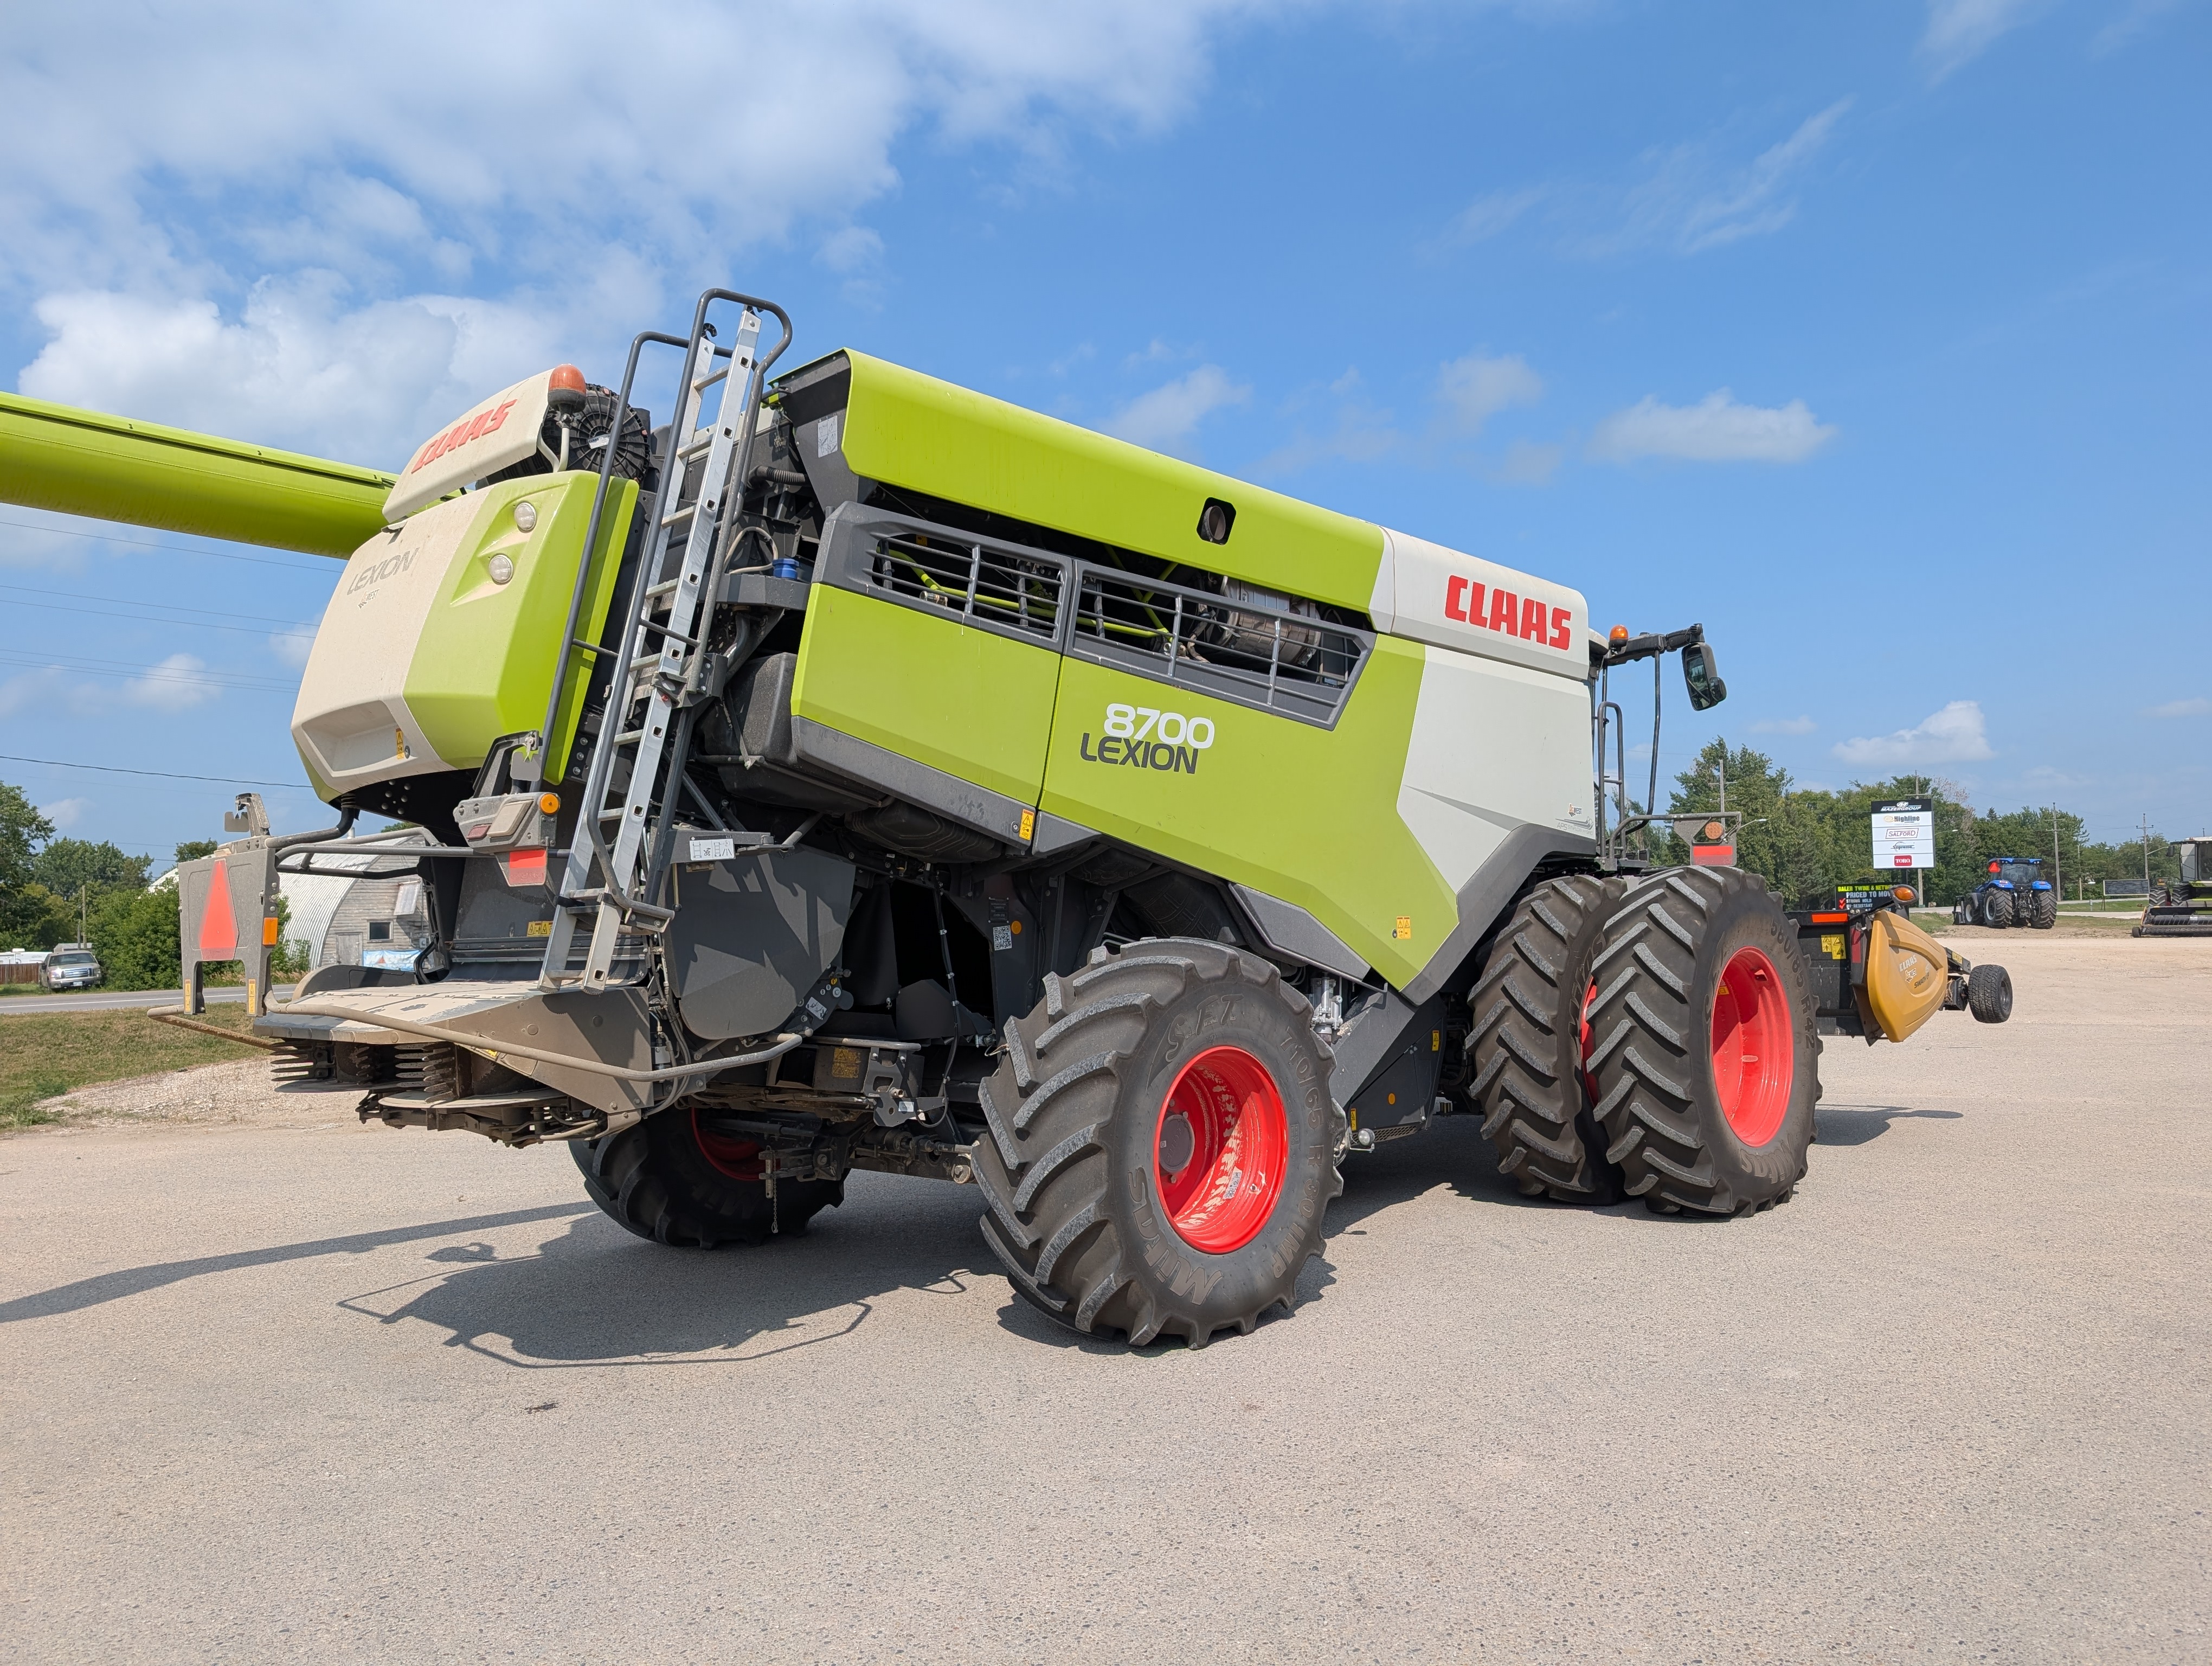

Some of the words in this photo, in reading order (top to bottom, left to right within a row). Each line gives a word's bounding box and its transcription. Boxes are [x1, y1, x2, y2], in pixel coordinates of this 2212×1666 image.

[411, 399, 518, 475] CLAAS
[346, 547, 420, 595] LEXION
[1445, 575, 1571, 651] CLAAS
[1080, 732, 1199, 774] LEXION
[1104, 703, 1215, 749] 8700
[1557, 822, 1567, 830] APS
[1770, 915, 1805, 988] 580/85
[1899, 954, 1917, 972] CLAAS
[1165, 994, 1244, 1062] SFT
[1280, 1026, 1324, 1130] 710/65
[1128, 1167, 1223, 1306] Mitas
[1272, 1223, 1306, 1279] IMP
